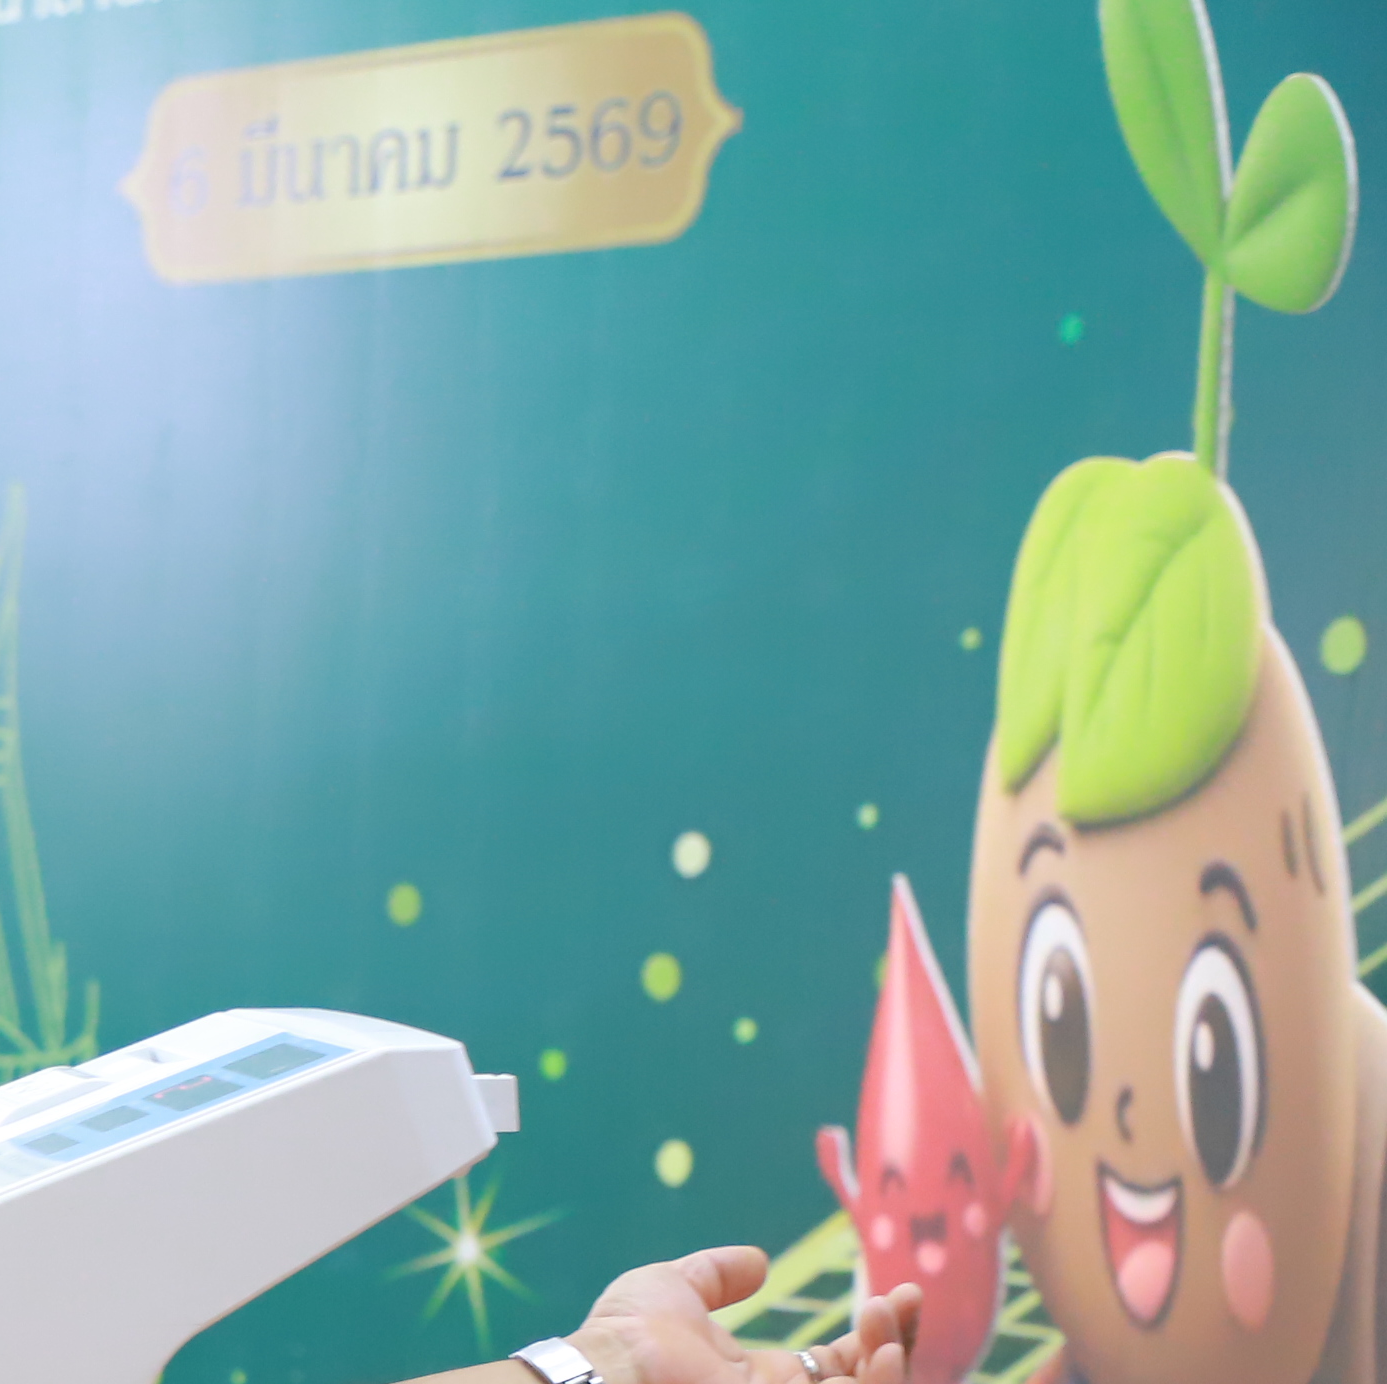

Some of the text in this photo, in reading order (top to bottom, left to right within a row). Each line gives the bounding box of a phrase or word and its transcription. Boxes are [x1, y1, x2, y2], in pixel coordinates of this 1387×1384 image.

[236, 116, 461, 209] มีนาคม
[496, 89, 684, 183] 2569
